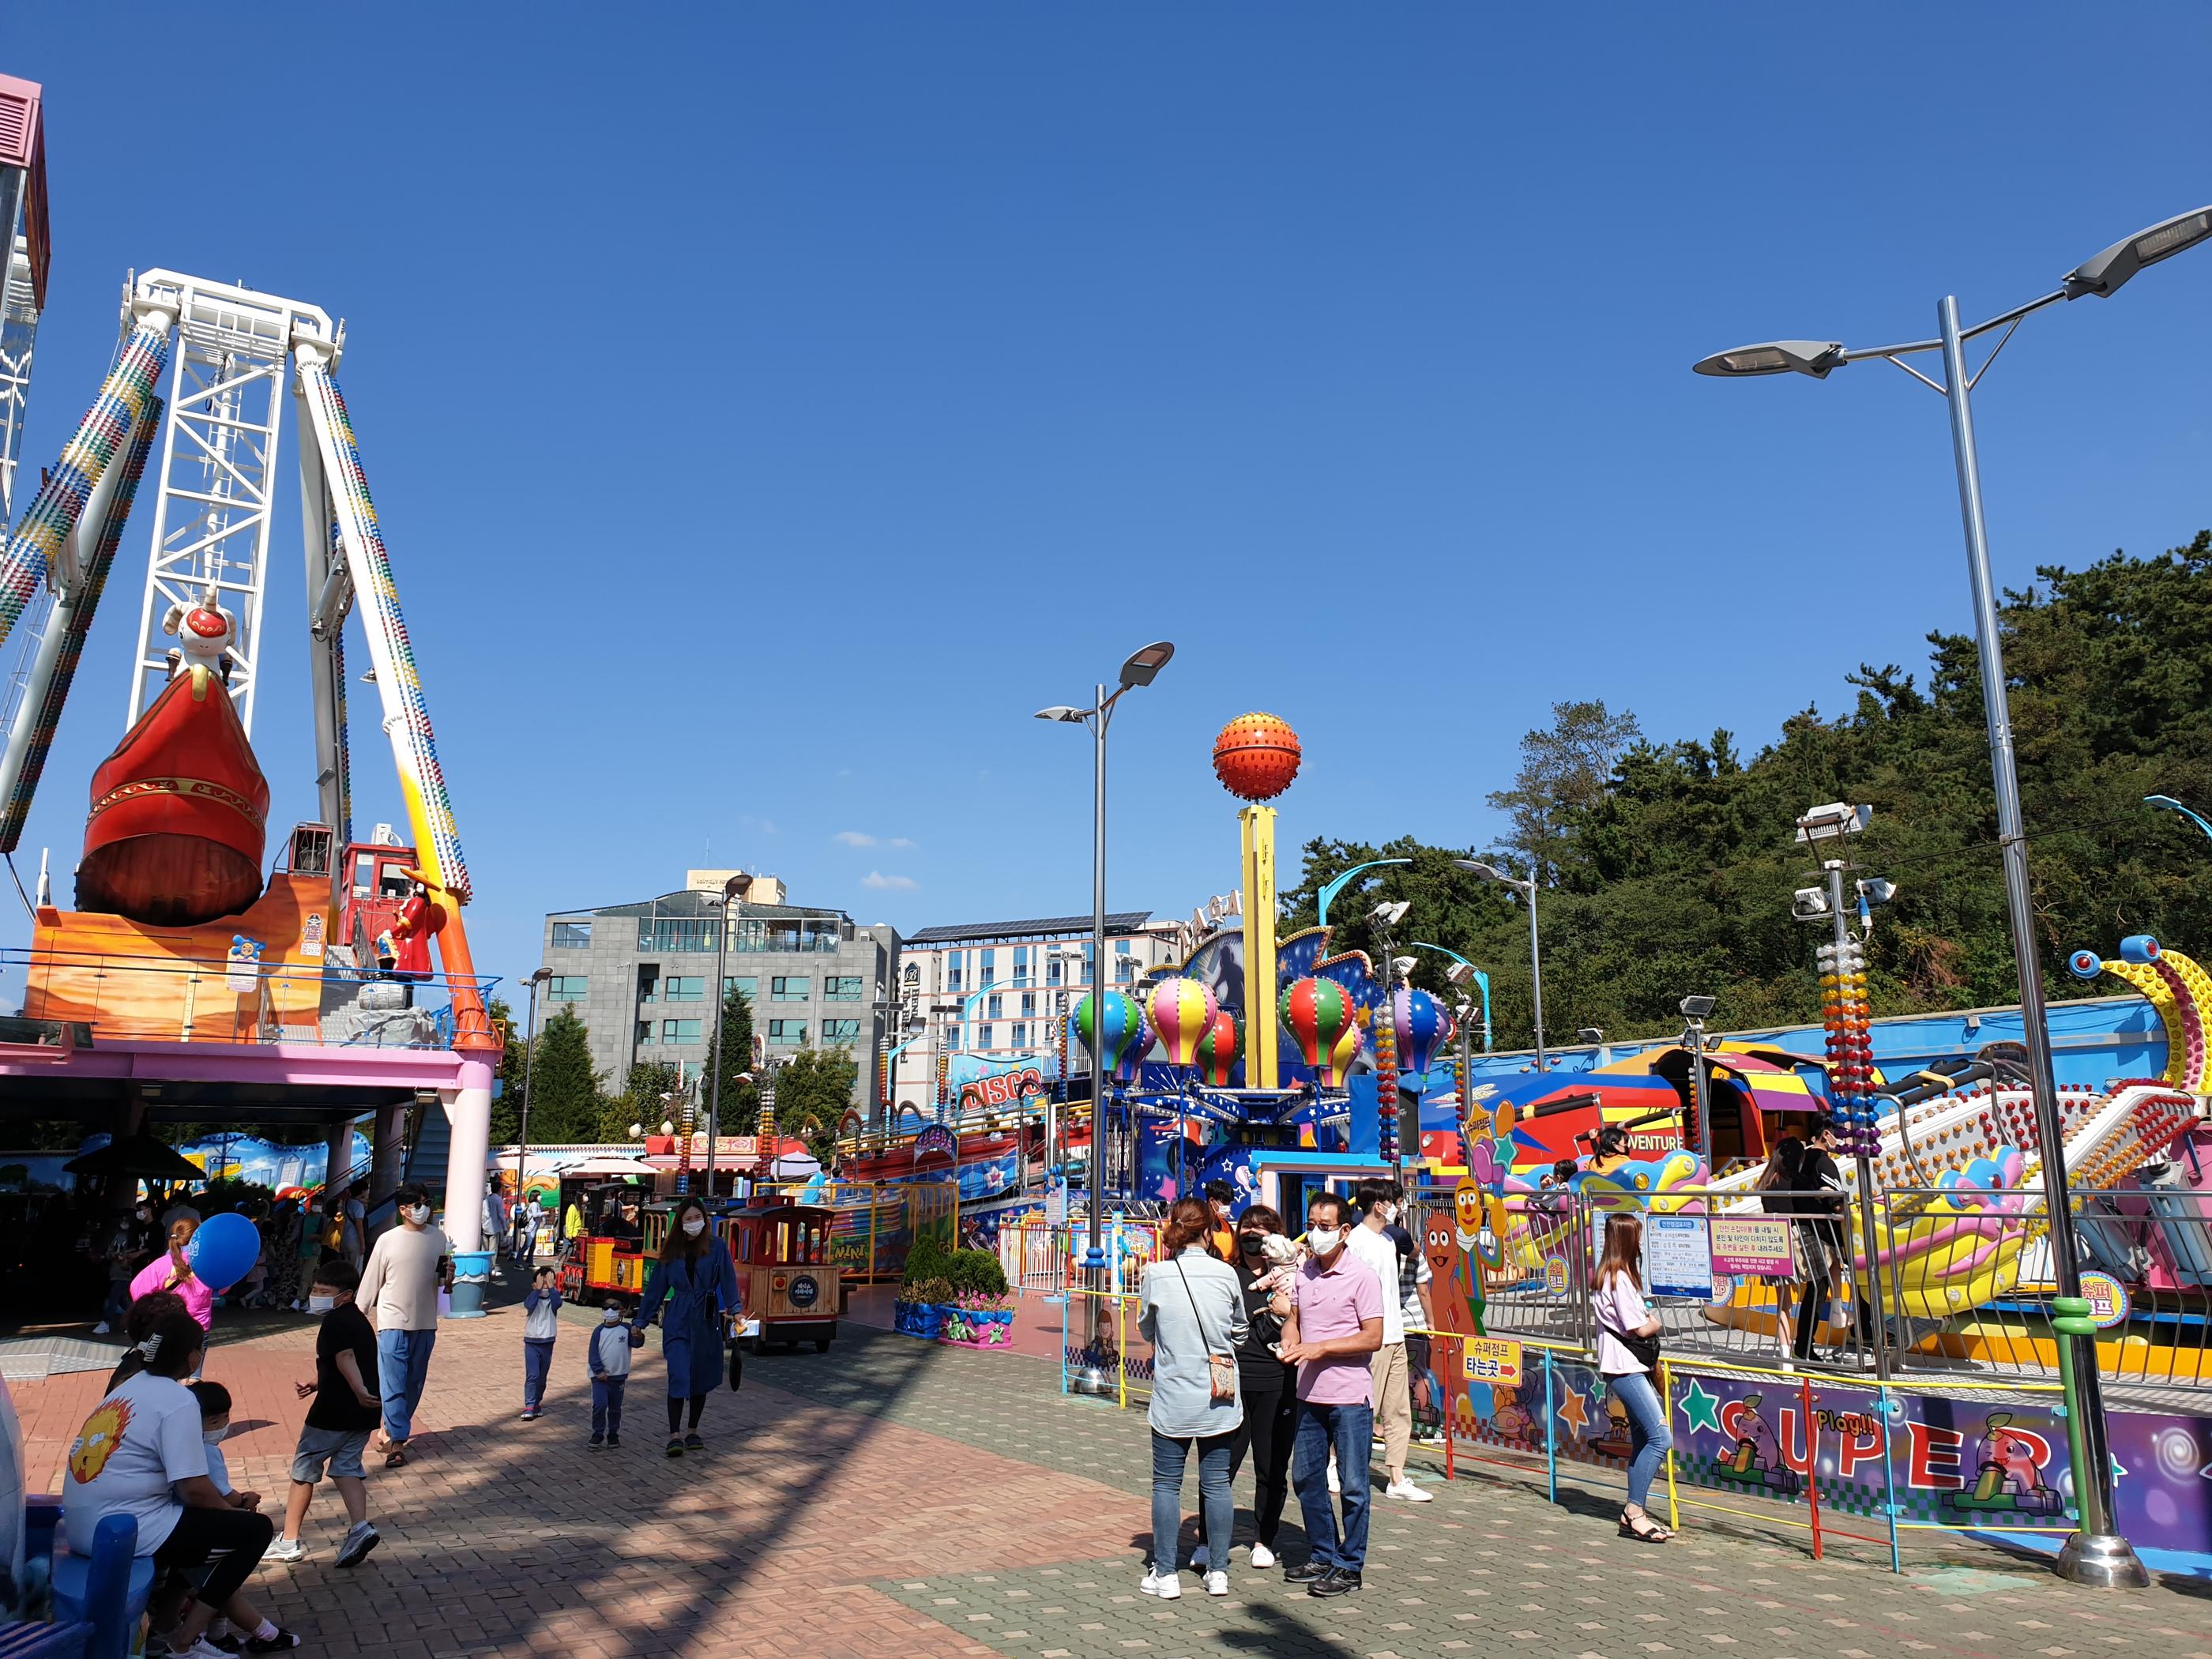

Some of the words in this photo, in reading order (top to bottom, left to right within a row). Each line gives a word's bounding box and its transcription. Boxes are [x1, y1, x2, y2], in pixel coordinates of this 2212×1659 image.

[1177, 890, 1242, 948] TAGA
[911, 988, 920, 1018] BENI
[961, 1068, 1040, 1110] DISCO
[1468, 1116, 1491, 1134] 슈퍼점프
[1628, 1134, 1683, 1151] VENTURE
[1853, 1233, 1864, 1251] 9
[833, 1243, 866, 1260] MINI
[1548, 1262, 1563, 1274] 슈퍼
[1549, 1275, 1564, 1288] 점프
[1713, 1275, 1728, 1285] PER
[1713, 1284, 1726, 1296] MP
[2081, 1281, 2112, 1300] 슈퍼
[1474, 1341, 1509, 1356] 슈퍼점프
[1466, 1356, 1499, 1378] 타는곳
[1816, 1409, 1875, 1438] Play!!
